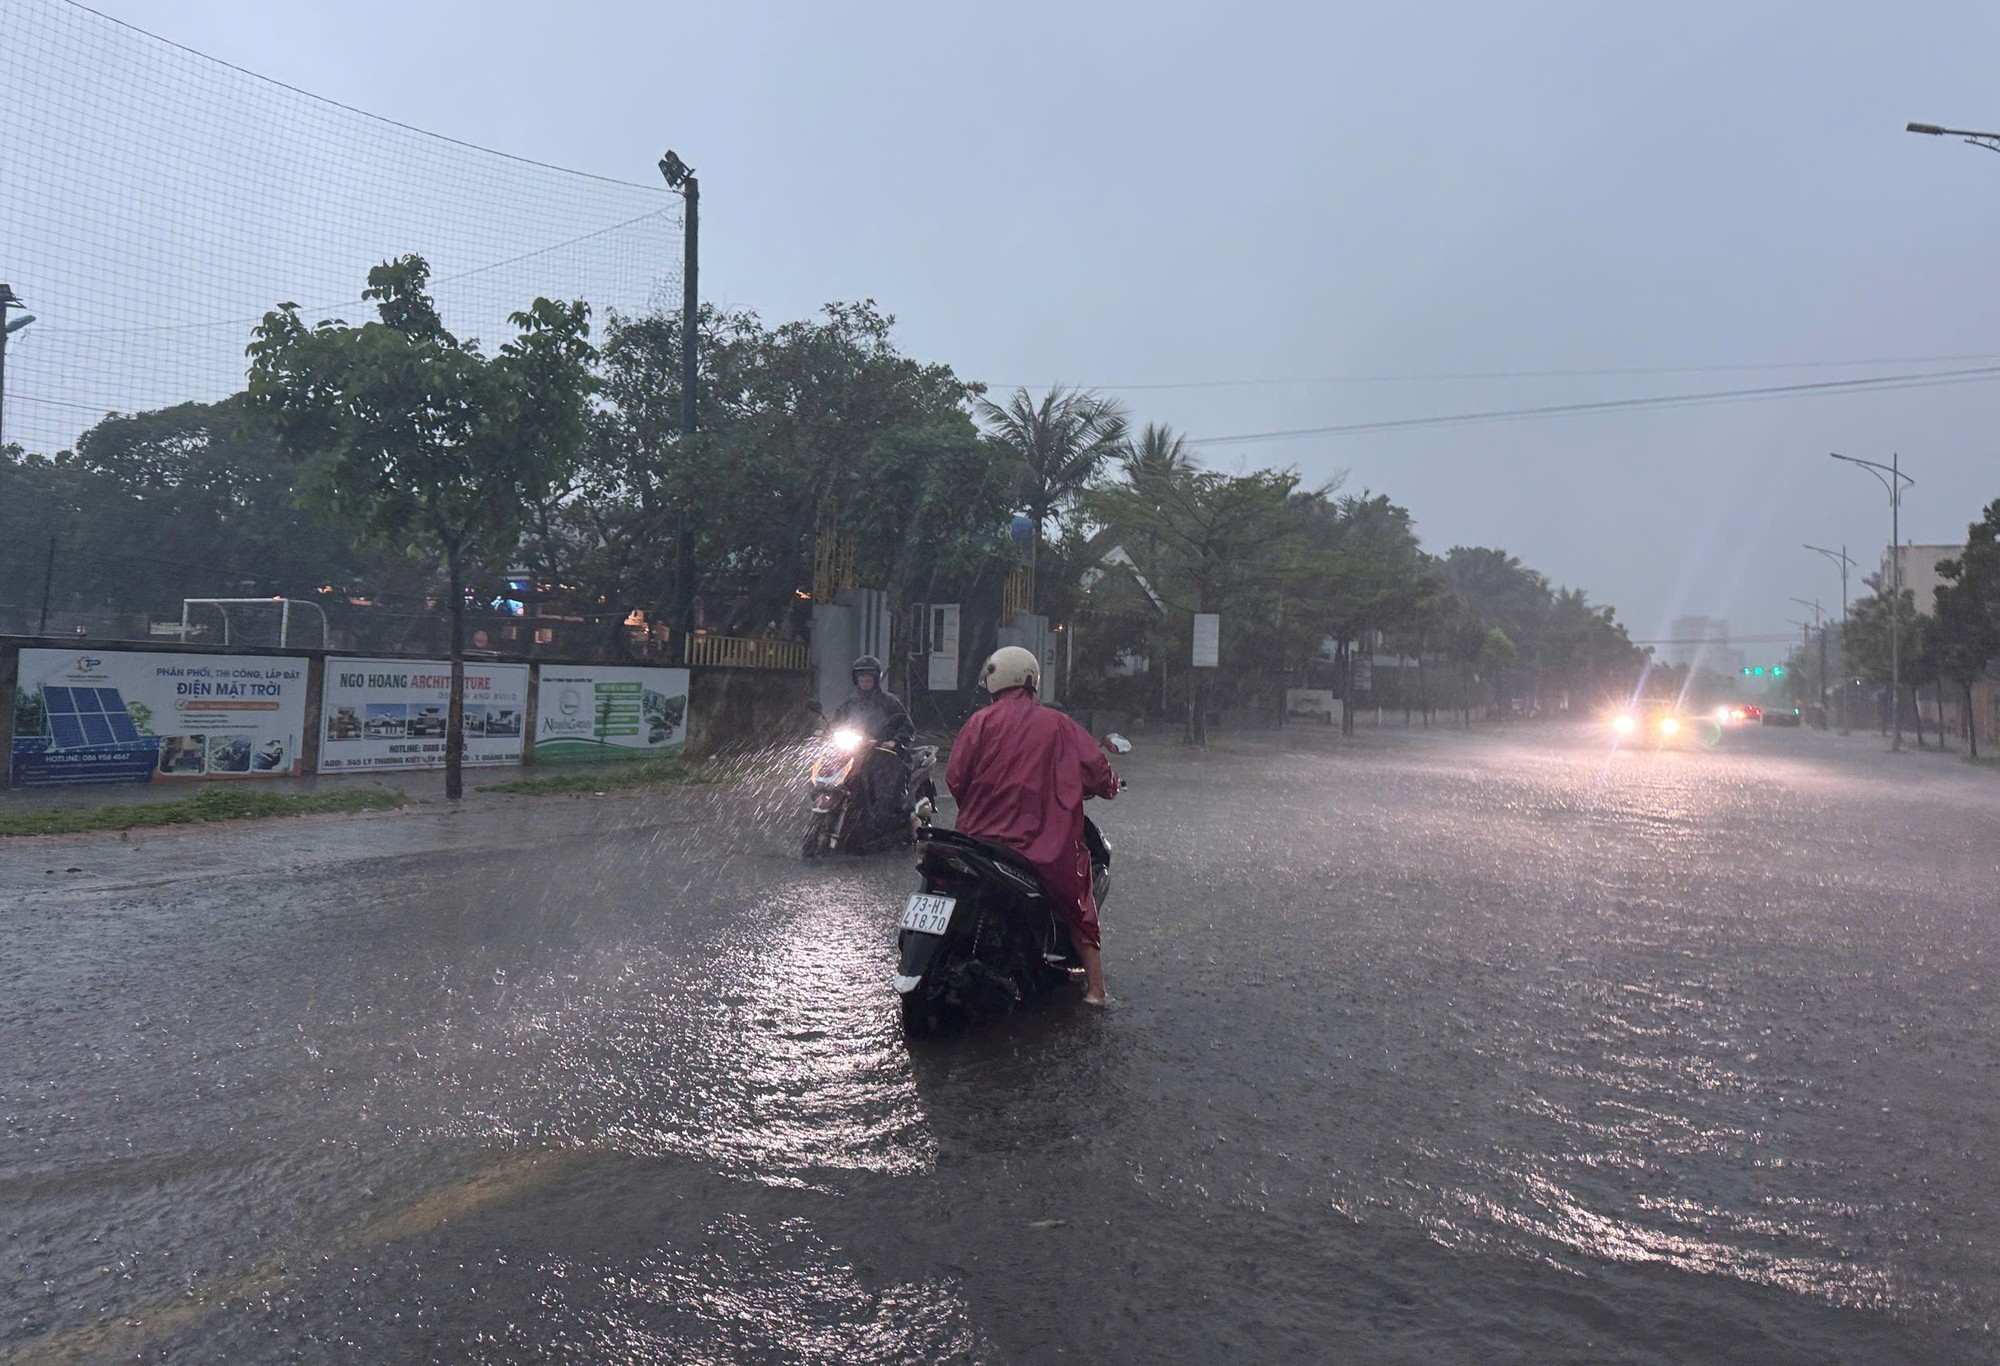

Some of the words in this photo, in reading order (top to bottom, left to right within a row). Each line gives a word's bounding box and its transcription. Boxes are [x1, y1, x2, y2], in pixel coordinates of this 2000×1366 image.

[156, 667, 184, 676] PHÂN
[216, 669, 230, 677] THI
[177, 680, 211, 698] ĐIỆN
[216, 681, 246, 699] MẶT
[251, 681, 281, 696] TRỜI
[340, 673, 364, 688] NGO
[368, 674, 407, 688] HOANG
[411, 675, 491, 690] ARCHITTURE
[389, 744, 421, 753] HOTLINE:
[912, 897, 946, 915] 73-H1
[903, 912, 946, 931] 418.70
